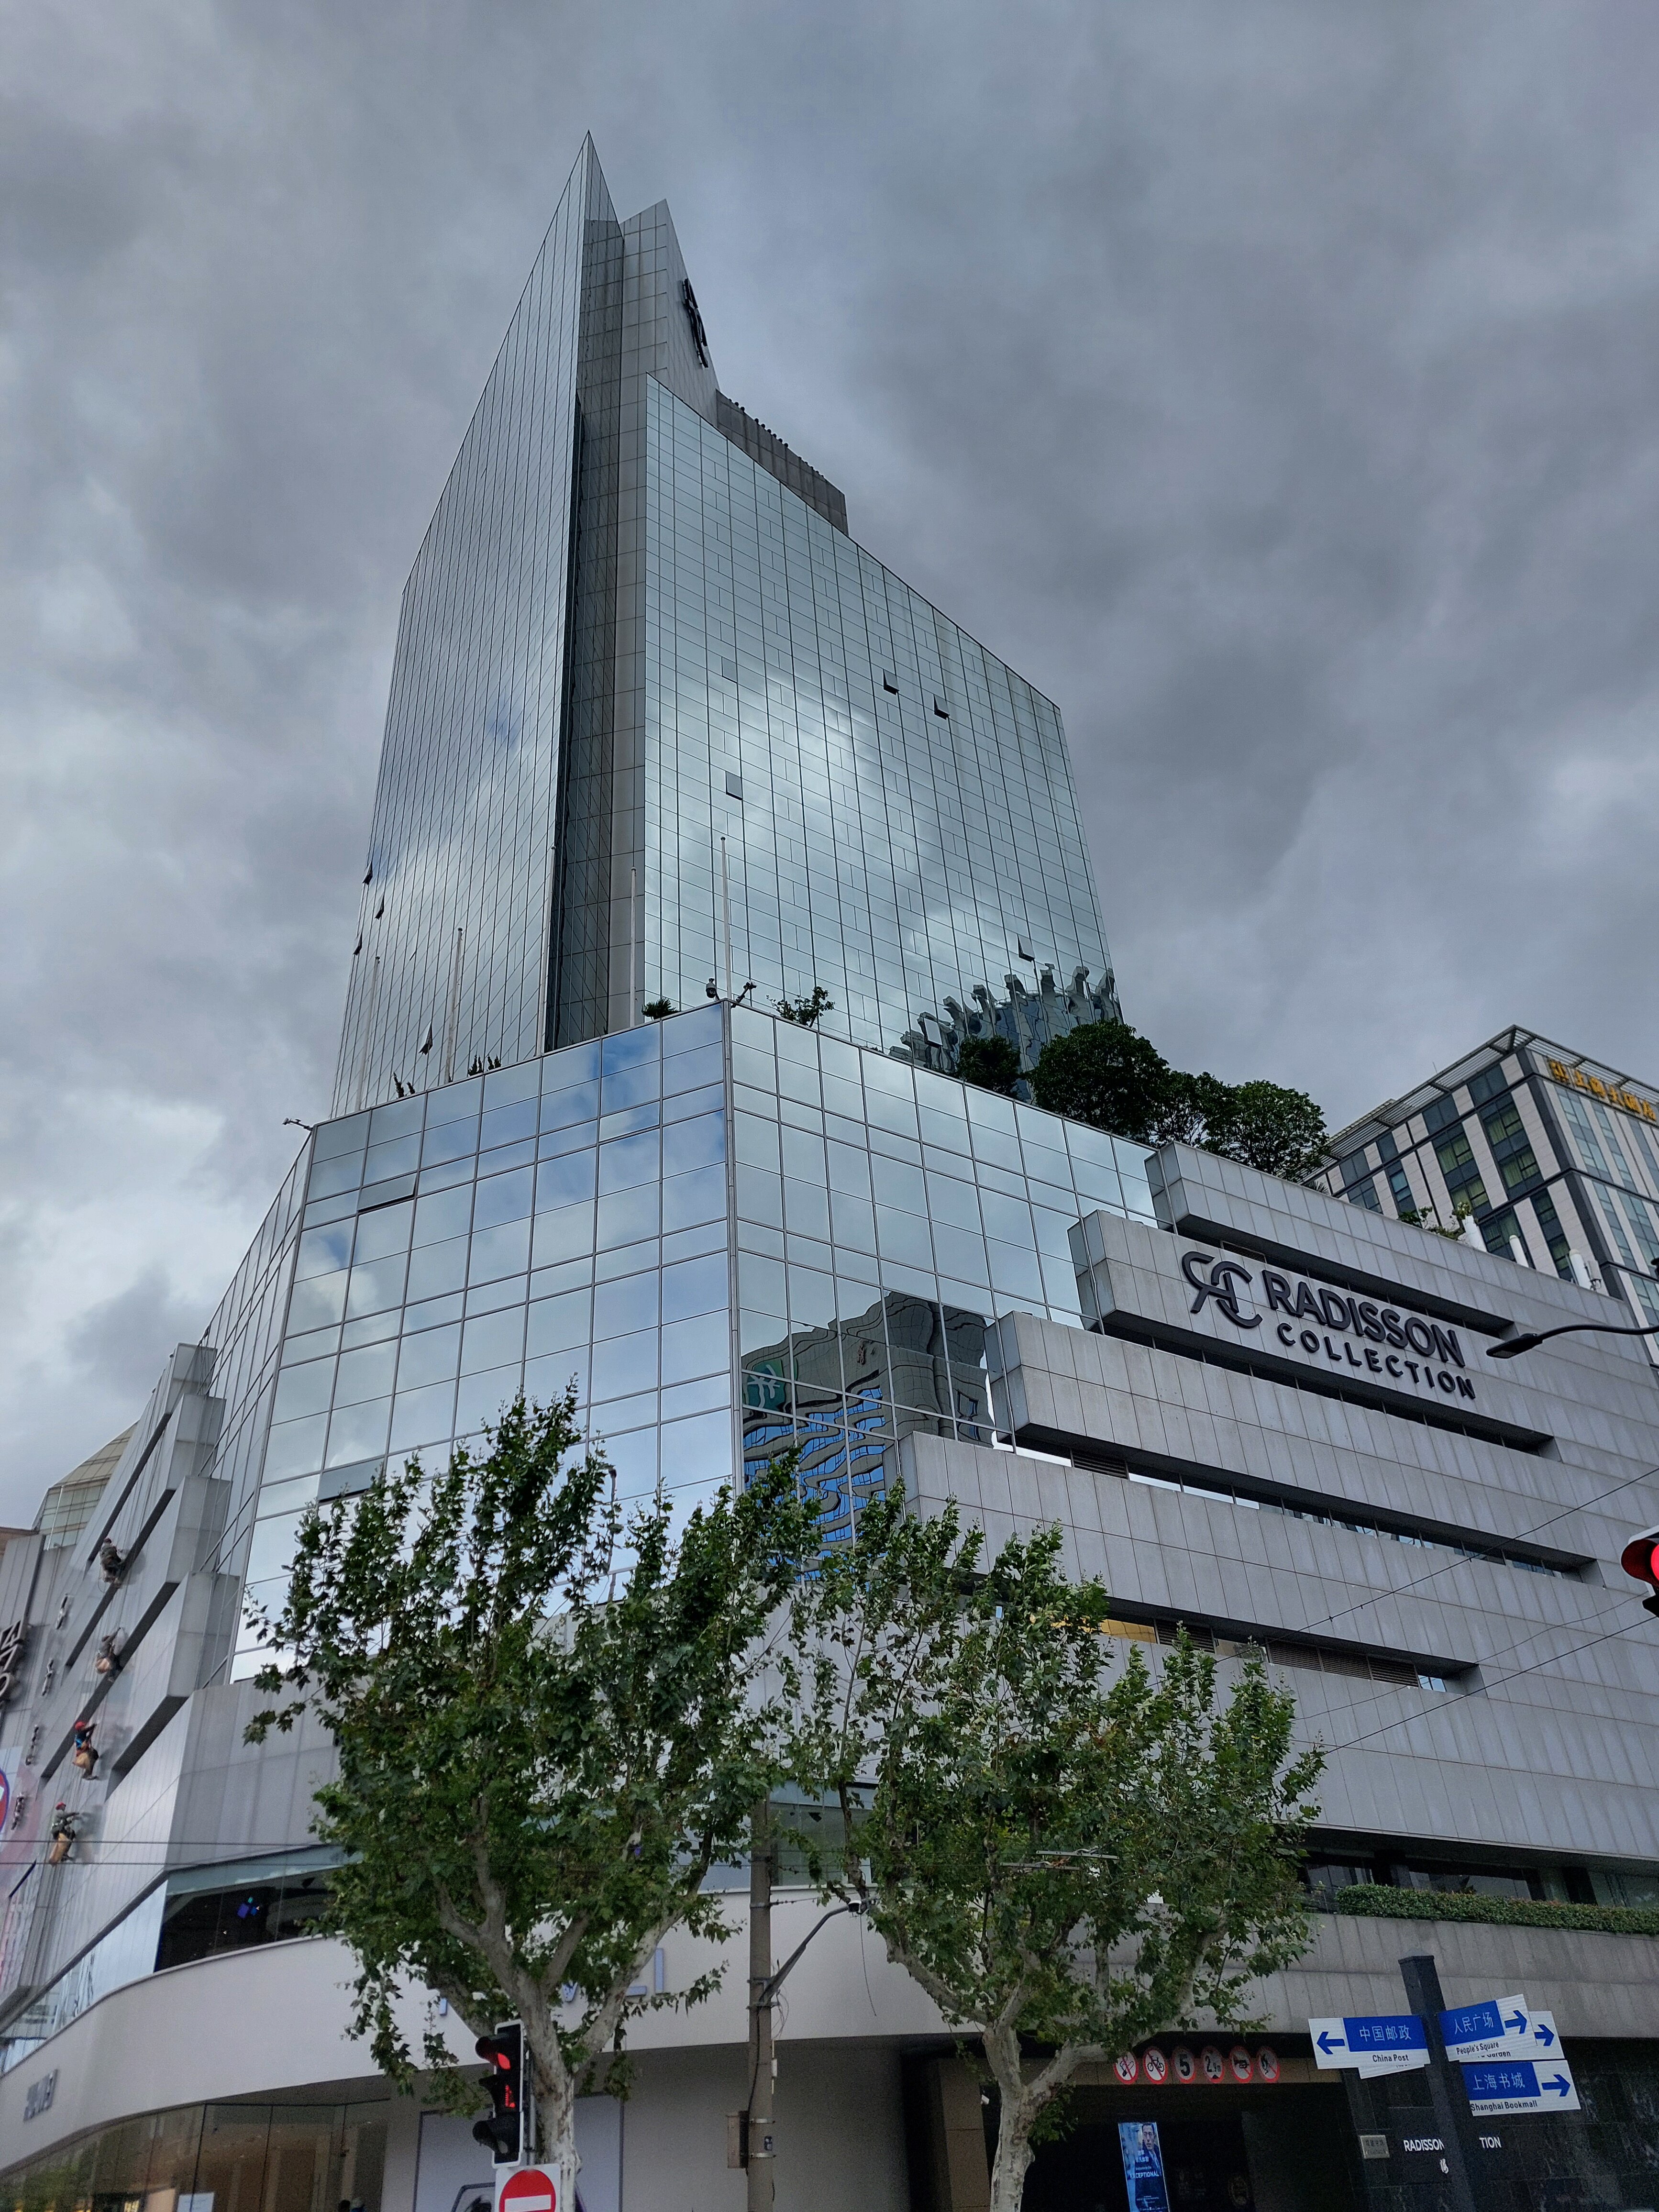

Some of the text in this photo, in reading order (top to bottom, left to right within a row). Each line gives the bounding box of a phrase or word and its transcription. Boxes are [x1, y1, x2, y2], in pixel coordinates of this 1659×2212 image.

[1261, 1269, 1466, 1367] RADISSON
[1277, 1322, 1477, 1400] COLLECTION
[1454, 2011, 1494, 2035] 人民广场
[1359, 2024, 1412, 2042] 中国邮政
[1456, 2042, 1499, 2055] People's Square
[1178, 2053, 1191, 2077] 5
[1372, 2055, 1392, 2063] China
[1473, 2072, 1526, 2090] 上海书城
[1471, 2100, 1538, 2112] Shanghai Bookmall
[1129, 2170, 1160, 2179] EXCEPTIONAL
